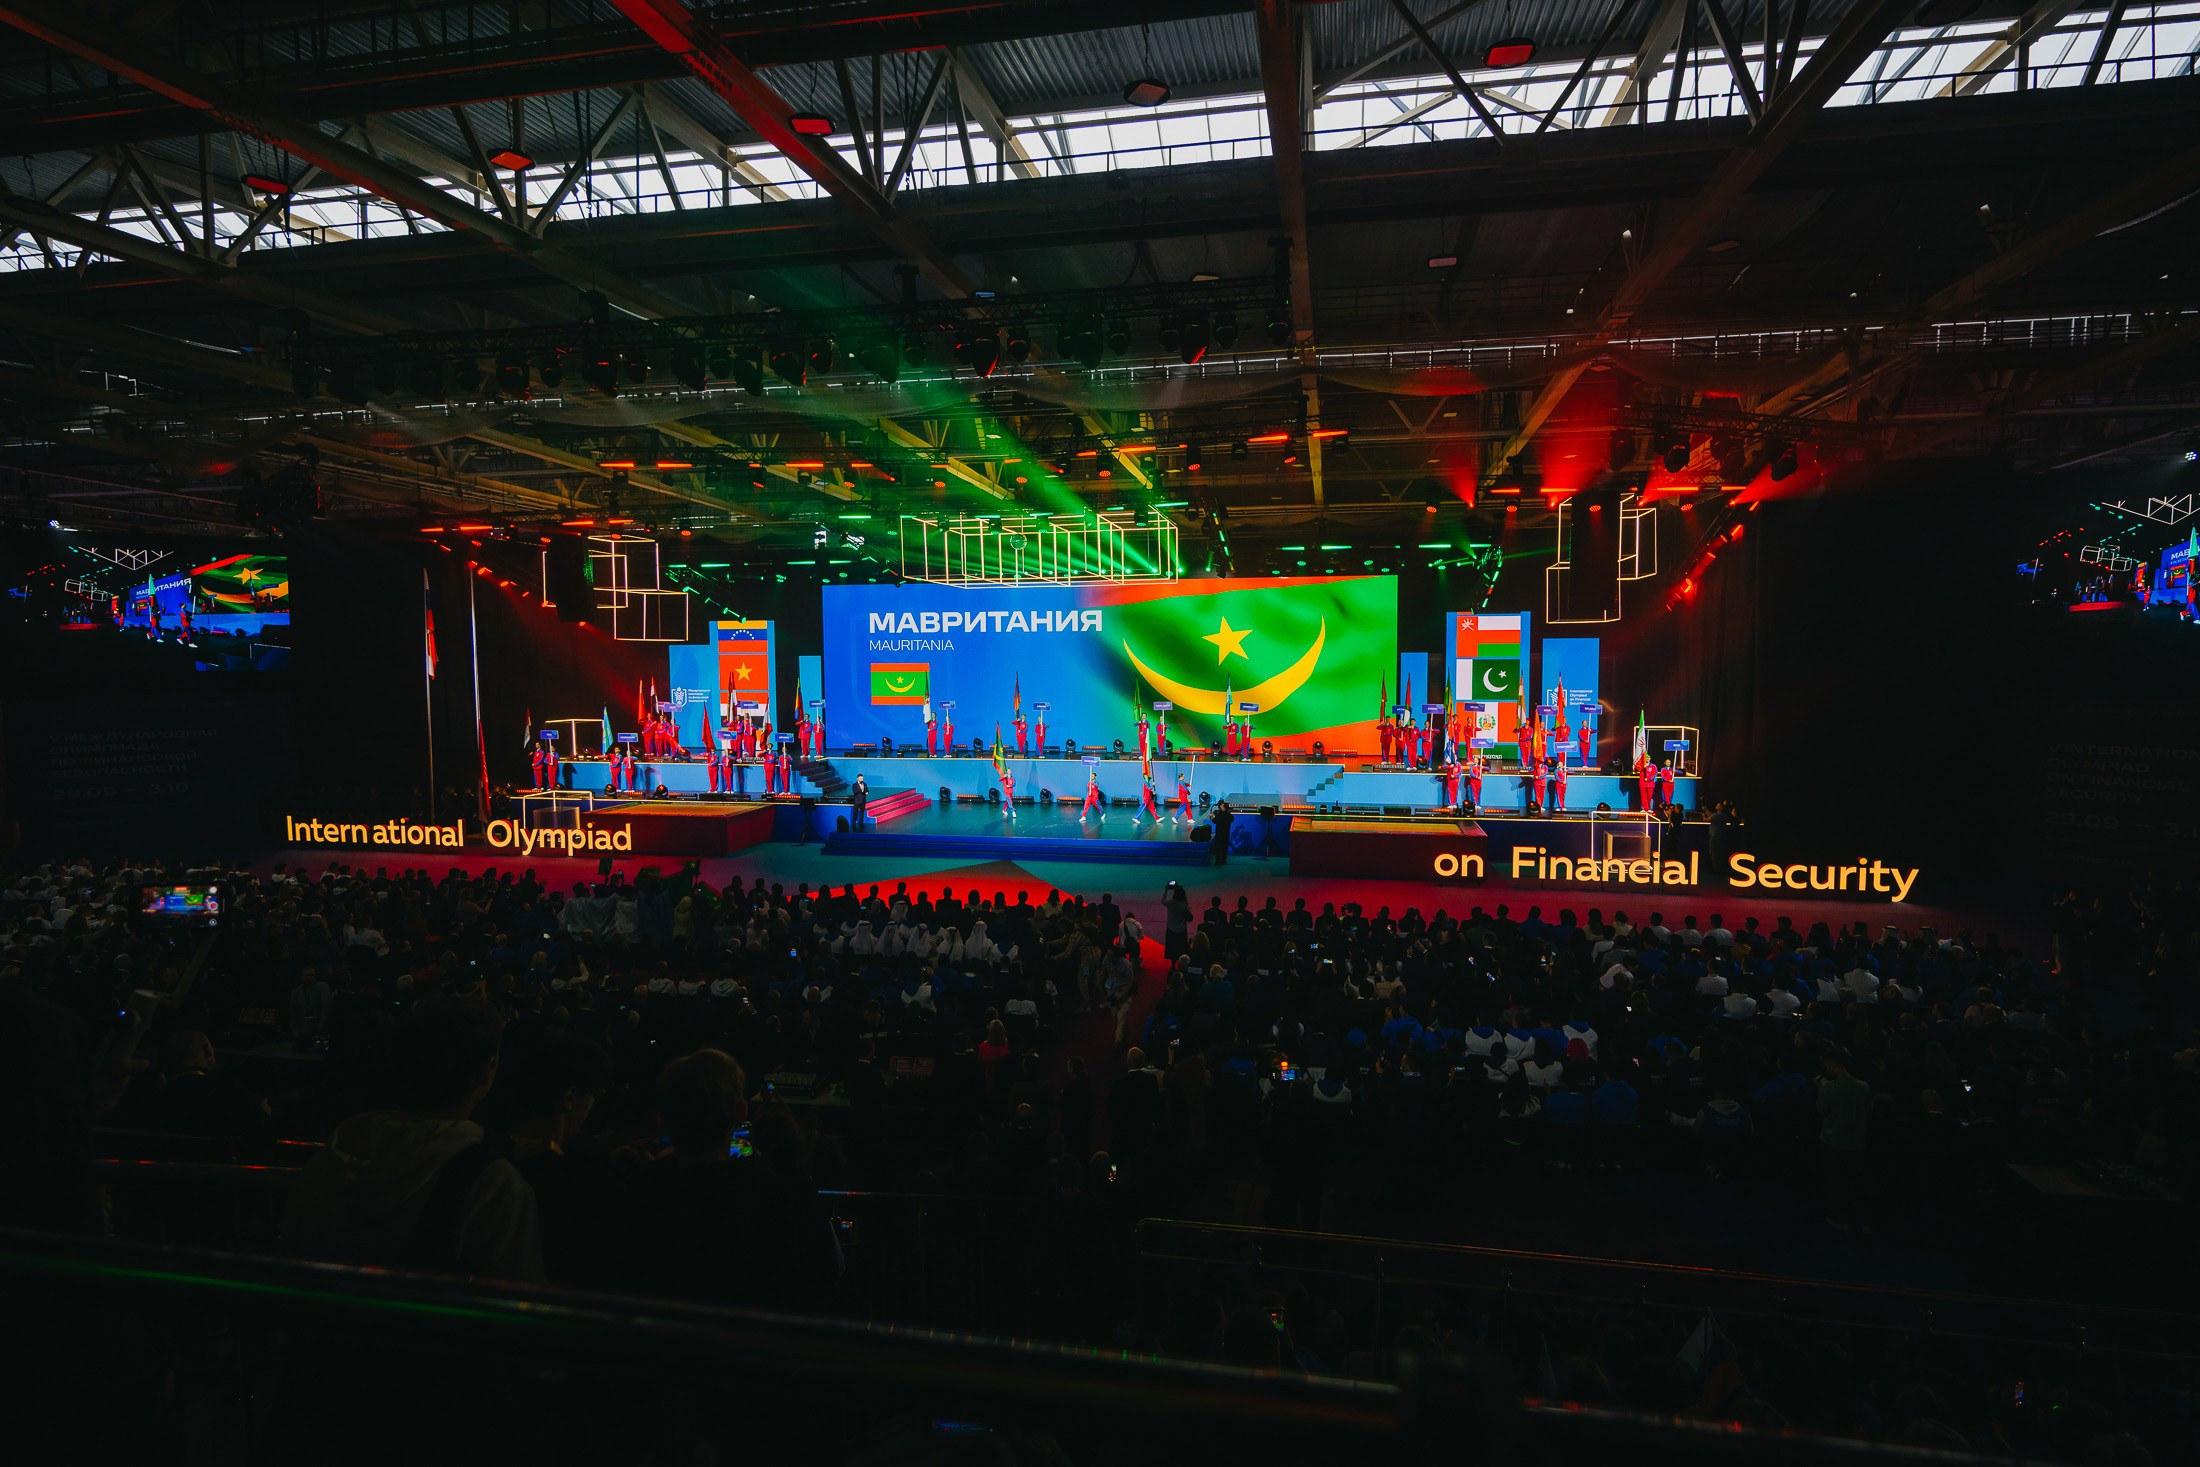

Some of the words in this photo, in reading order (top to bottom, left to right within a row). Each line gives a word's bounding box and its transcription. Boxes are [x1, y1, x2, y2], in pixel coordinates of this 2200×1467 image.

[869, 609, 1103, 634] МАВРИТАНИЯ
[869, 639, 955, 651] MAURITANIA
[487, 819, 632, 857] Olympiad
[1434, 852, 1484, 878] on
[1512, 846, 1699, 886] Financial
[1728, 853, 1919, 903] Security
